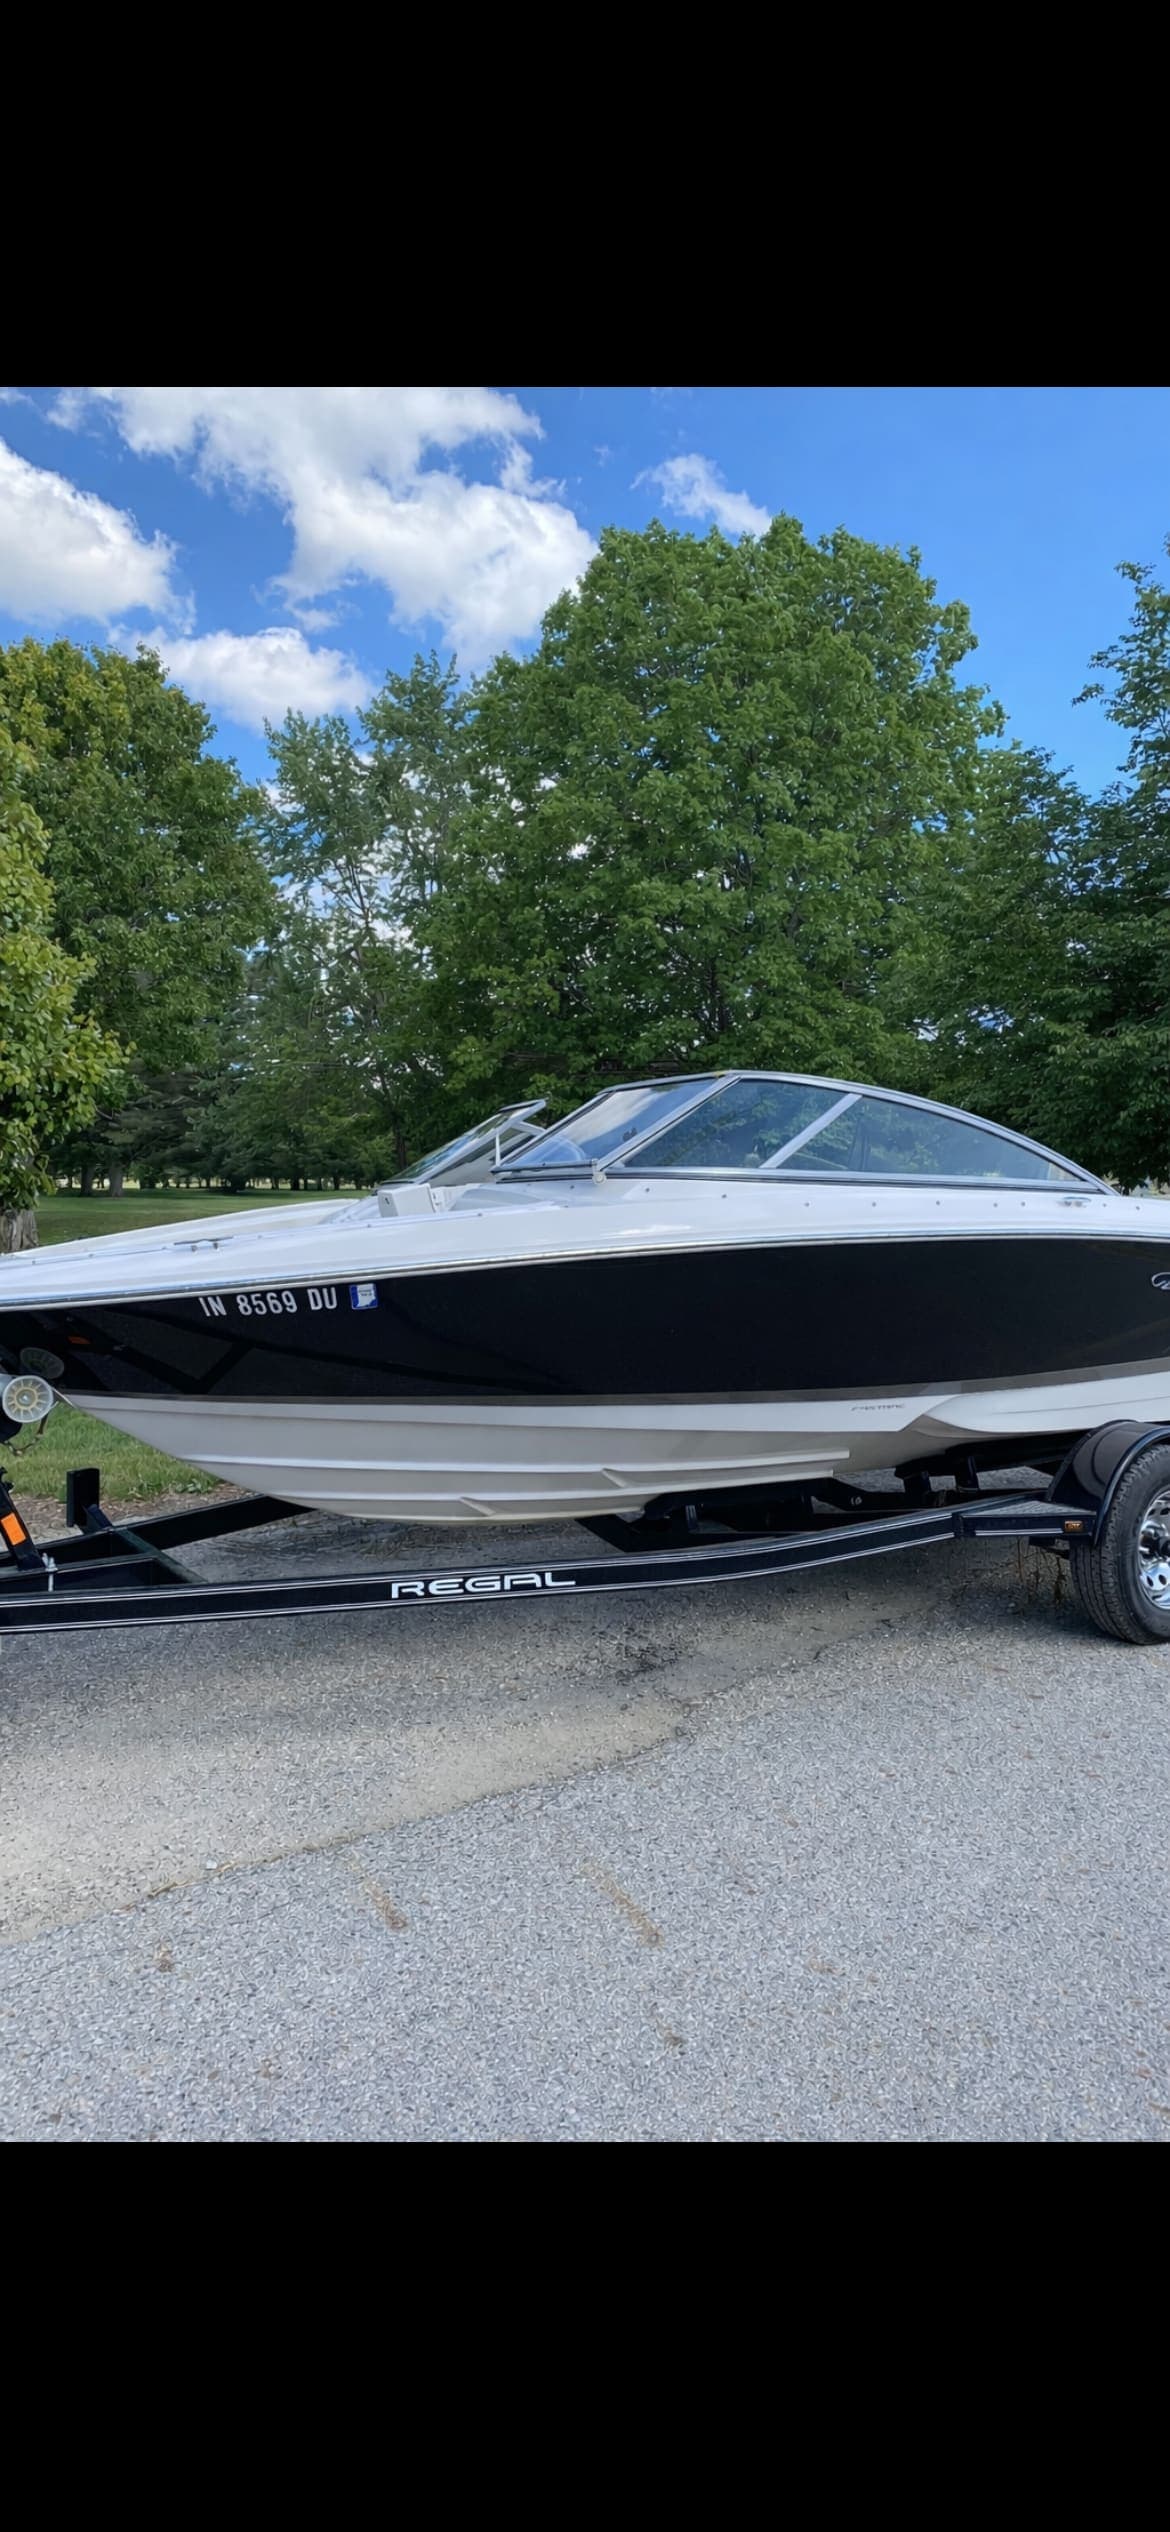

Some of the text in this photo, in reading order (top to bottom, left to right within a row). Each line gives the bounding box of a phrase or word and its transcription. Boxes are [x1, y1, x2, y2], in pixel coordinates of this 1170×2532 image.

[198, 1287, 338, 1317] IN 8569 DU
[391, 1572, 576, 1599] REGAL
